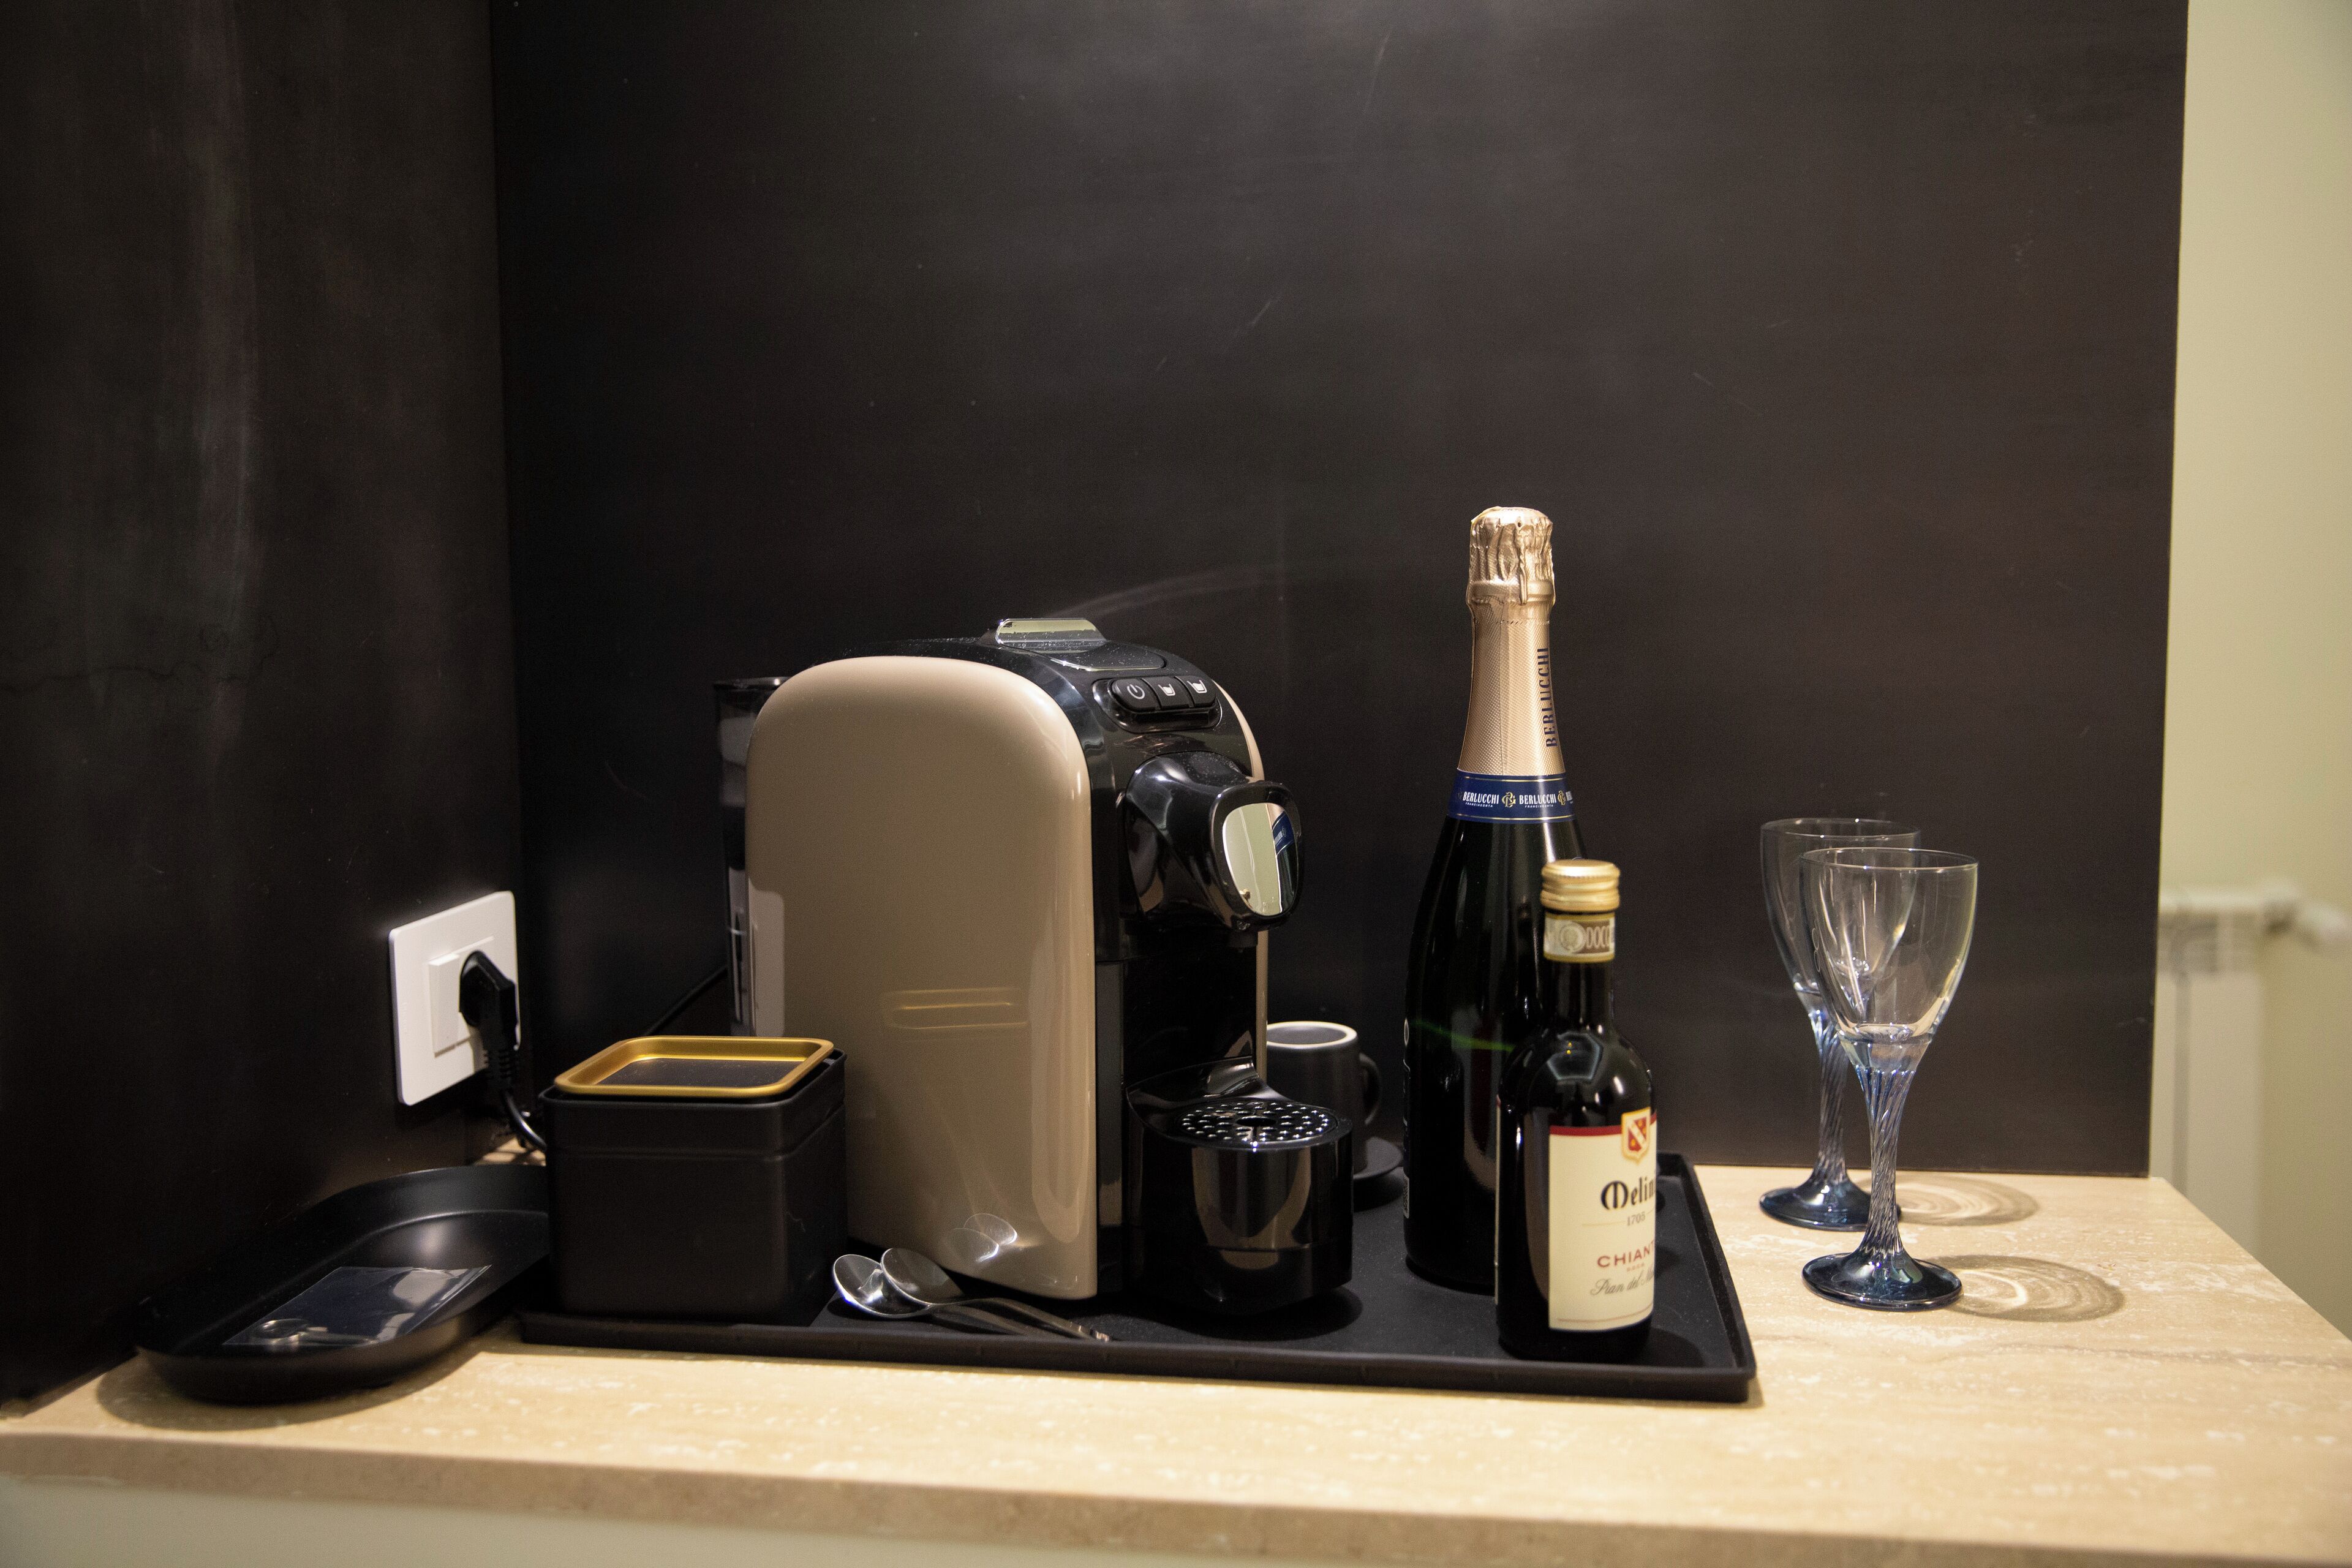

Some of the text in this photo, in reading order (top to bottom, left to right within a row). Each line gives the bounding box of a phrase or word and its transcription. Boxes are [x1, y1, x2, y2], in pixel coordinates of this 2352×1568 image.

[1537, 647, 1558, 747] BERLUCCHI
[1463, 791, 1499, 804] BERLUCCHI
[1519, 793, 1557, 805] BERLUCCHI
[1627, 1212, 1646, 1227] 1705
